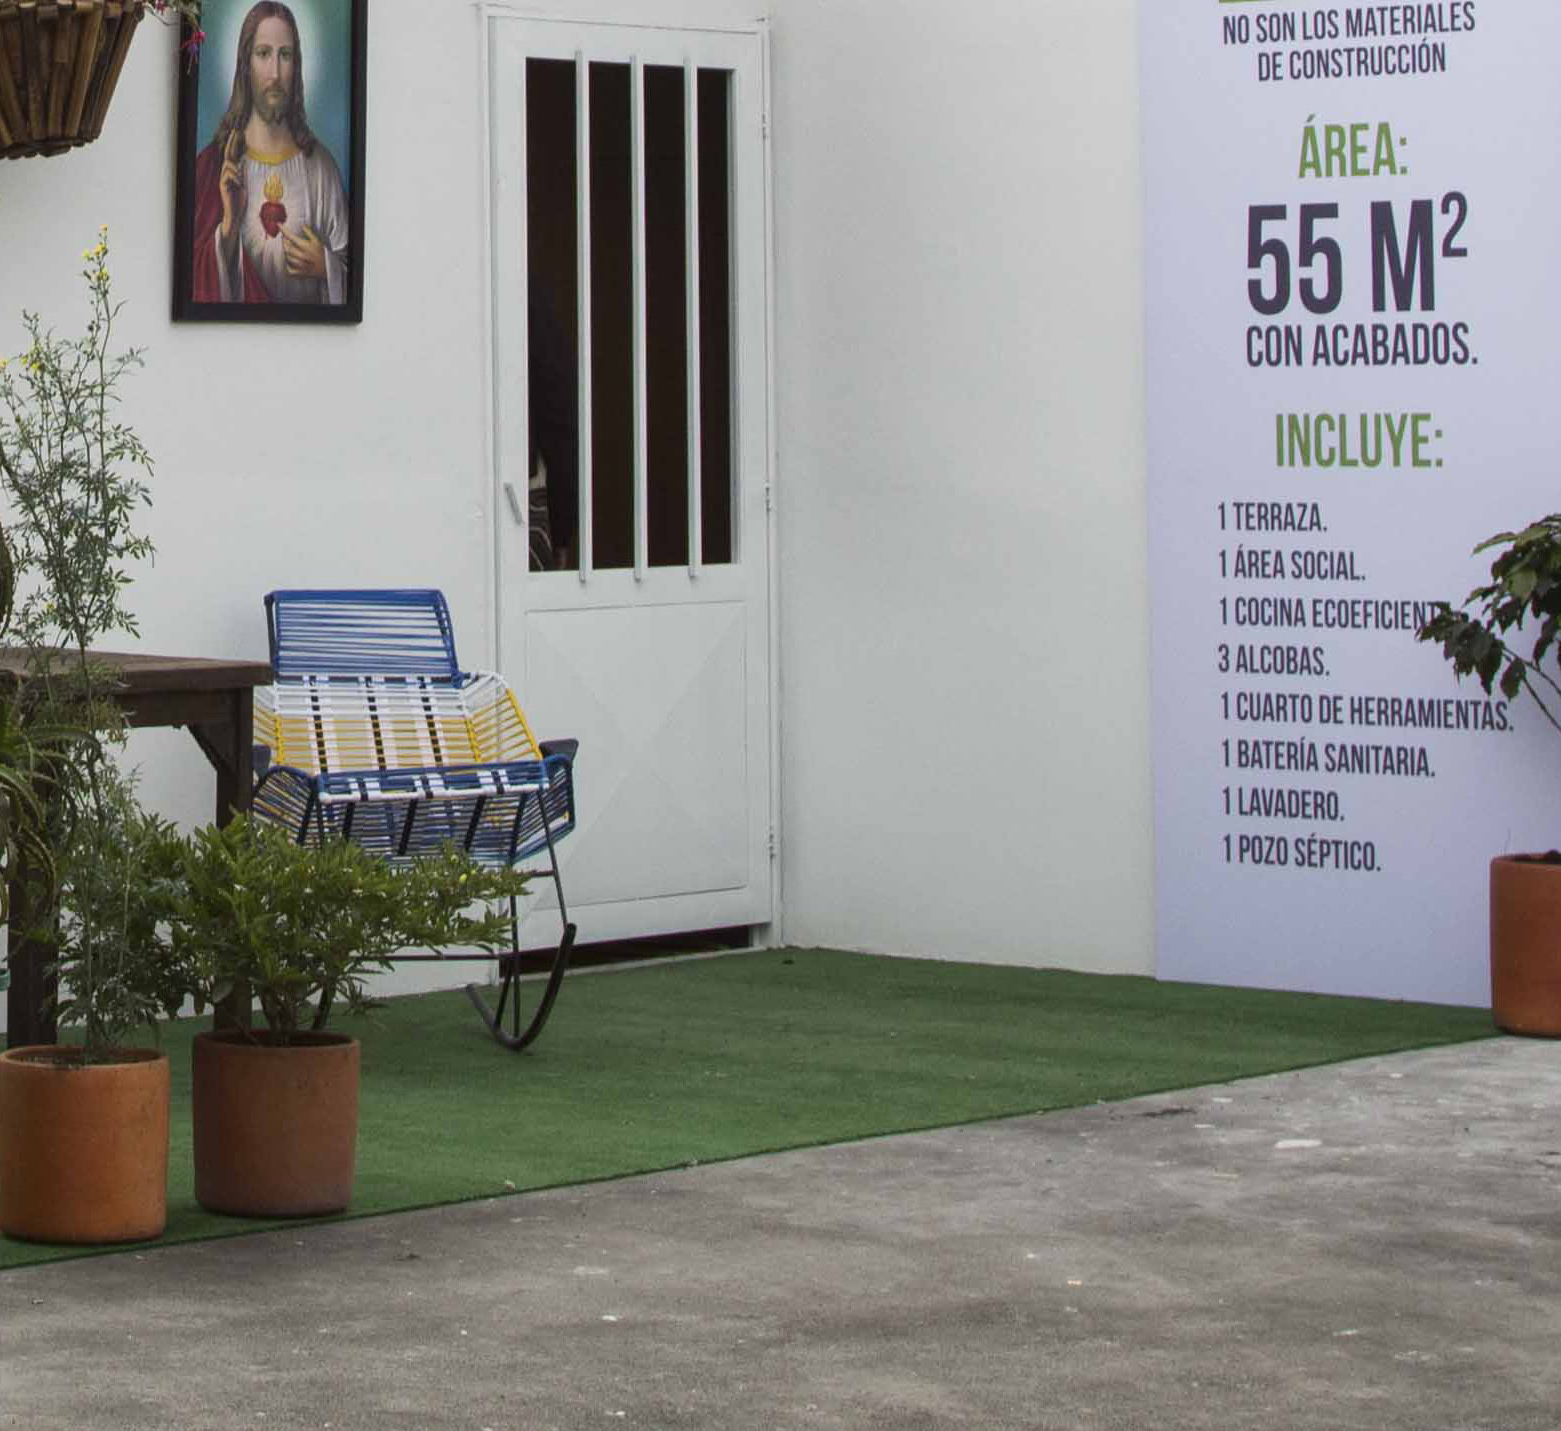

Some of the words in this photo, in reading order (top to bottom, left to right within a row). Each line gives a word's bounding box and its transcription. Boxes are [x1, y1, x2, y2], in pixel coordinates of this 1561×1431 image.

[1223, 13, 1250, 45] NO
[1256, 11, 1296, 43] SON
[1302, 9, 1340, 41] LOS
[1345, 1, 1476, 39] MATERIALES
[1258, 51, 1284, 82] DE
[1289, 37, 1446, 81] CONSTRUCCIÓN
[1298, 114, 1409, 178] ÁREA:
[1246, 202, 1343, 316] 55
[1246, 324, 1303, 367] CON
[1312, 321, 1478, 367] ACABADOS.
[1275, 413, 1444, 468] INCLUYE:
[1218, 501, 1227, 531] 1
[1232, 501, 1328, 532] TERRAZA.
[1219, 549, 1227, 579] 1
[1234, 544, 1286, 580] ÁREA
[1290, 549, 1366, 582] SOCIAL.
[1219, 597, 1228, 626] 1
[1234, 596, 1307, 628] COCINA
[1312, 599, 1447, 630] ECOEFICIENT
[1218, 643, 1229, 674] 3
[1235, 644, 1330, 677] ALCOBAS.
[1220, 691, 1229, 721] 1
[1236, 691, 1313, 724] CUARTO
[1319, 695, 1345, 725] DE
[1350, 696, 1515, 733] HERRAMIENTAS.
[1222, 738, 1230, 768] 1
[1237, 736, 1319, 772] BATERÍA
[1324, 742, 1436, 778] SANITARIA.
[1222, 786, 1231, 816] 1
[1238, 786, 1345, 822] LAVADERO.
[1223, 833, 1232, 863] 1
[1238, 833, 1288, 867] POZO
[1294, 832, 1382, 872] SÉPTICO.
